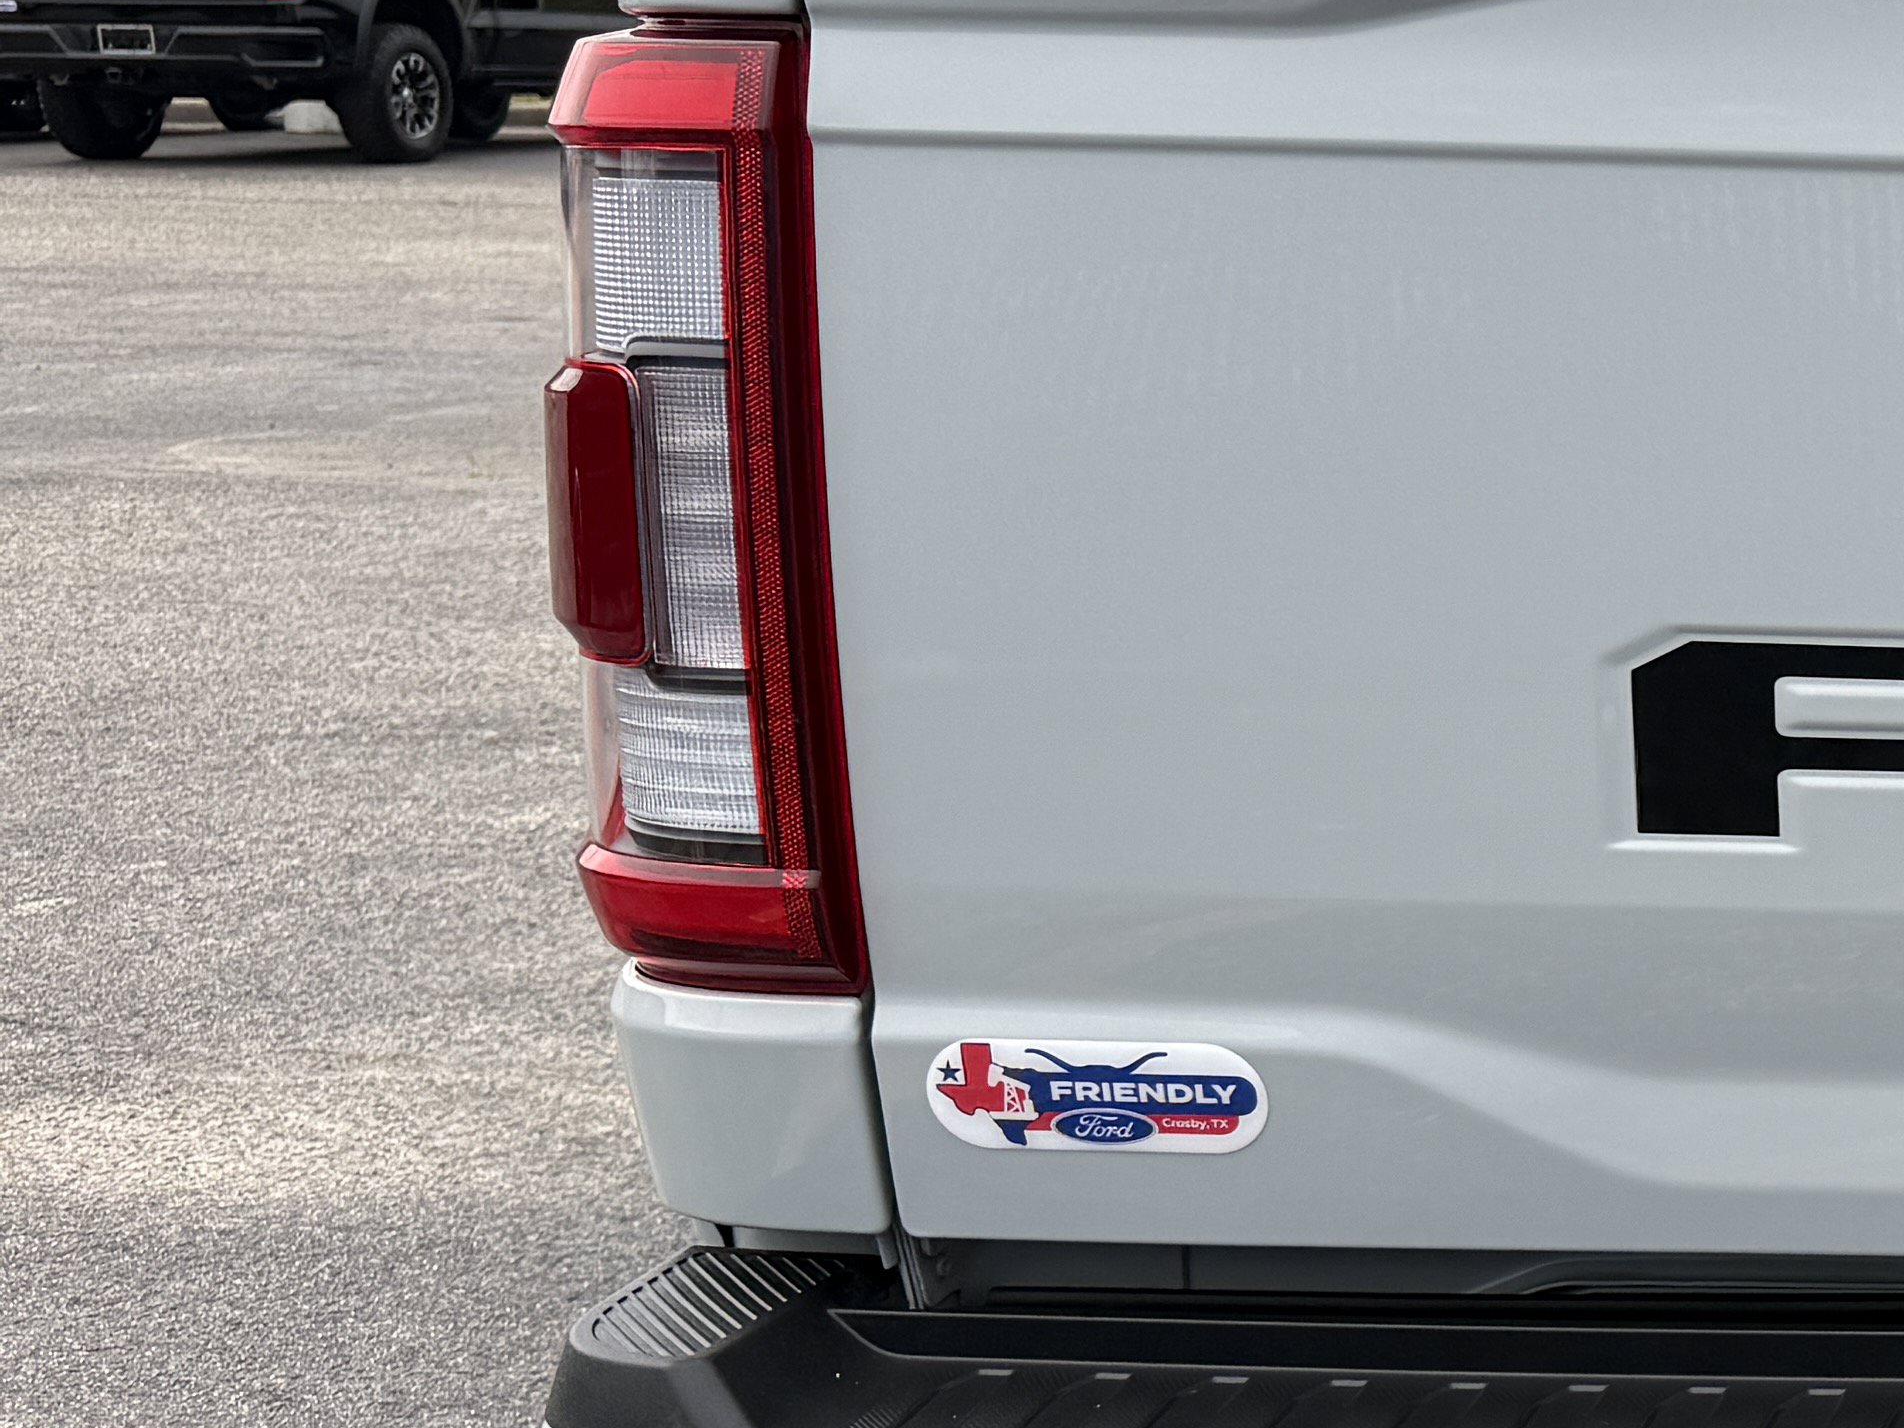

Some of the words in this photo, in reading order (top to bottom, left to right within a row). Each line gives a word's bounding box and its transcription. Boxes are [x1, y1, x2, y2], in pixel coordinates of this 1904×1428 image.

[1050, 1080, 1237, 1106] FRIENDLY
[1074, 1114, 1135, 1139] Ford
[1162, 1117, 1210, 1130] Crosby,
[1210, 1118, 1229, 1129] TX
